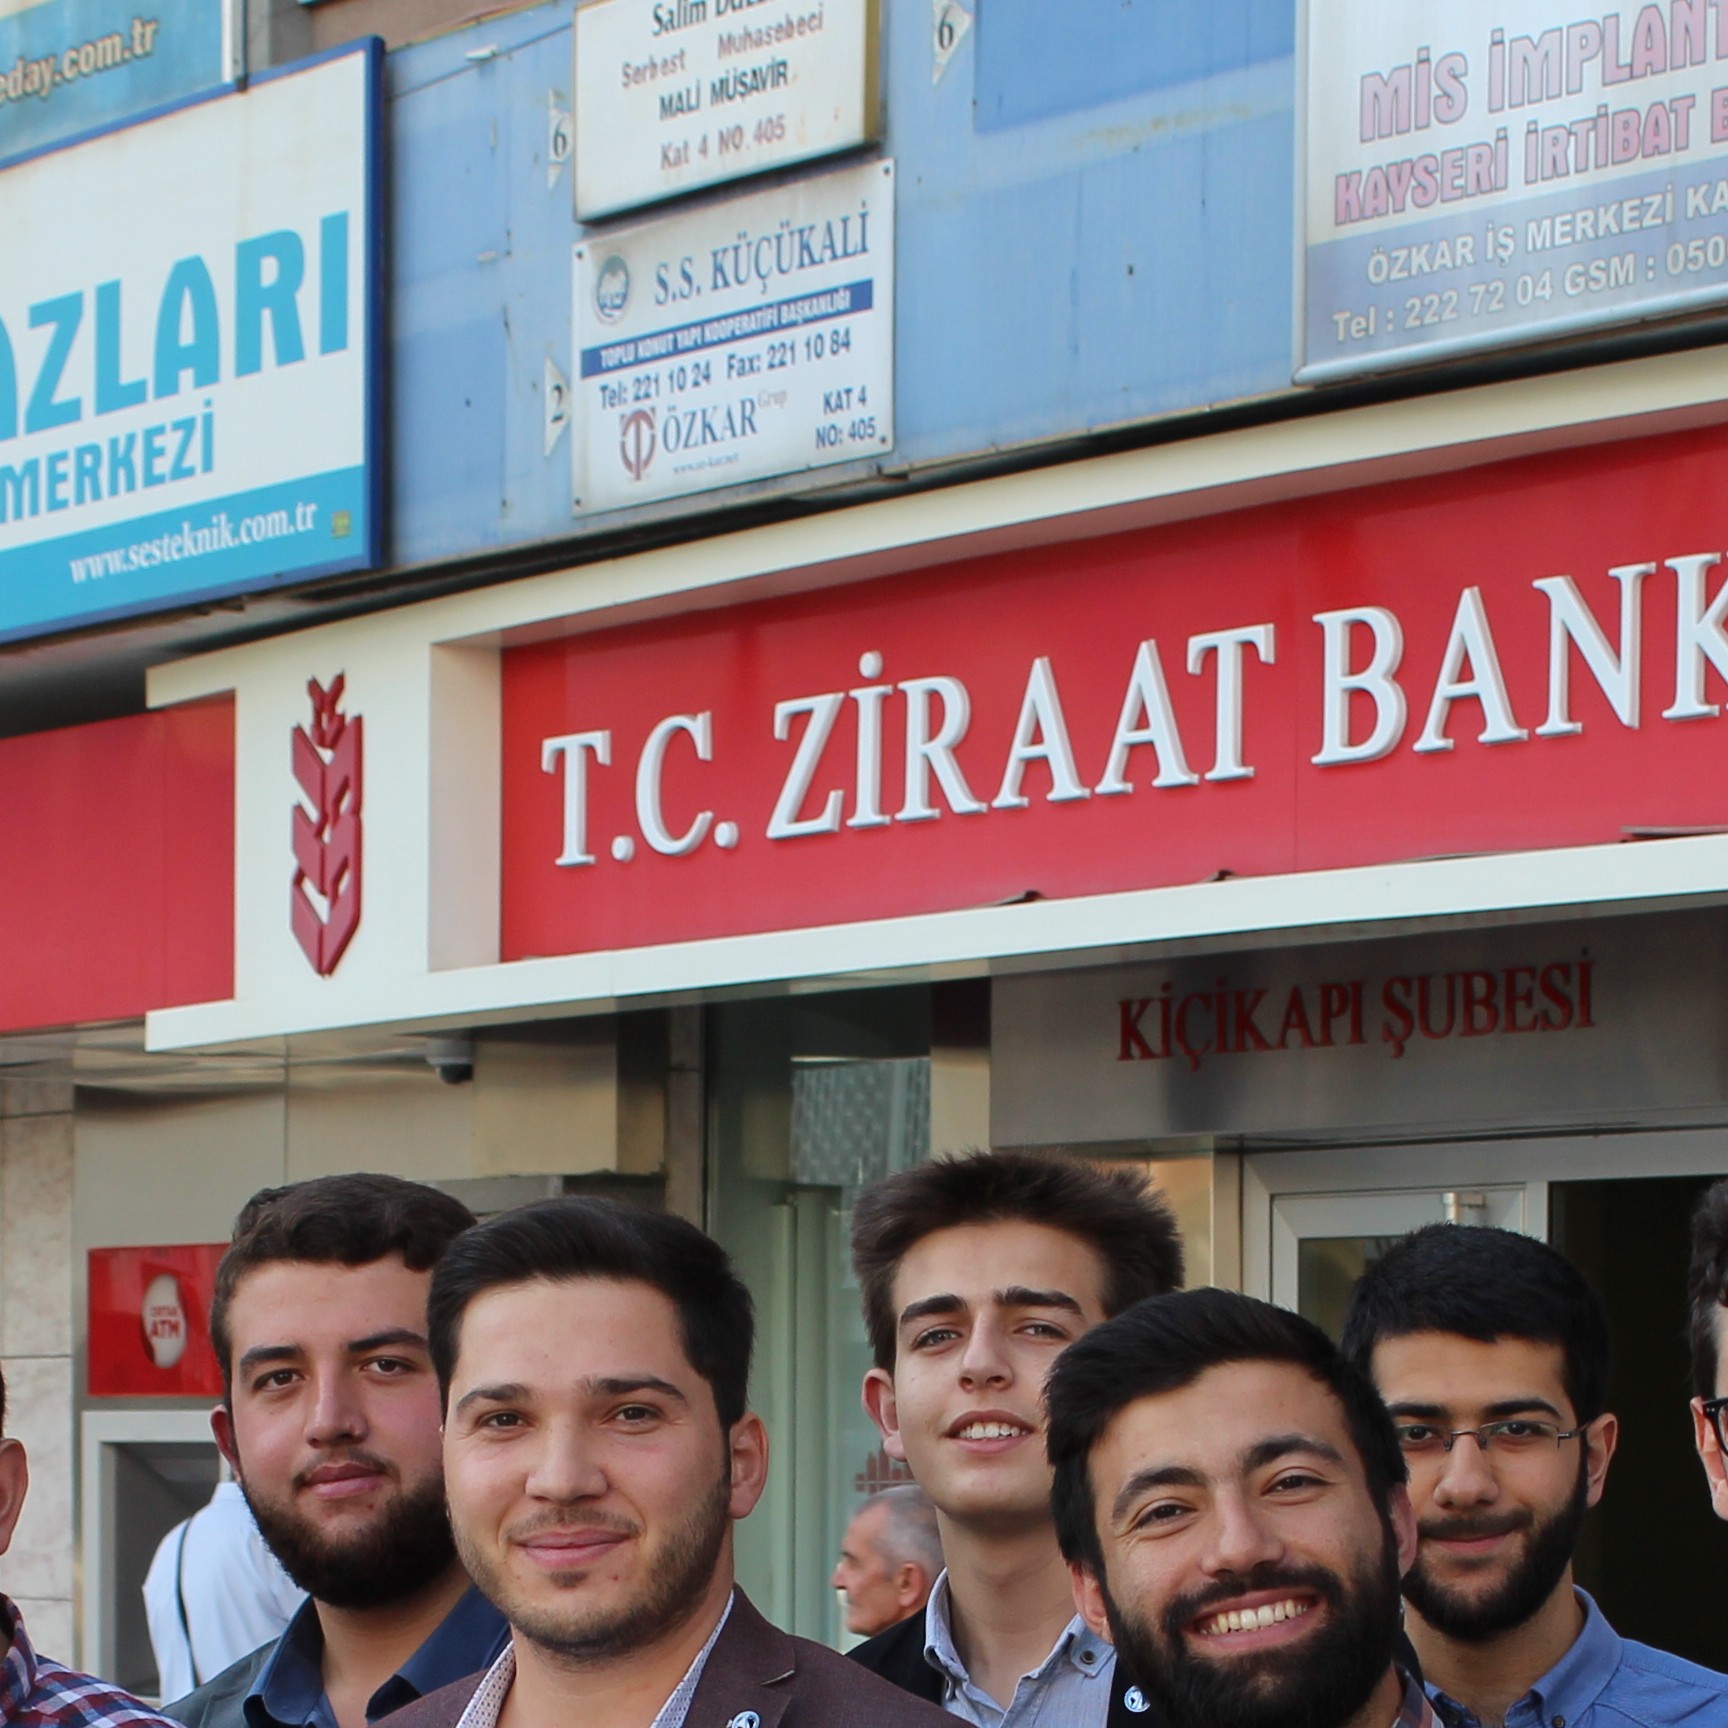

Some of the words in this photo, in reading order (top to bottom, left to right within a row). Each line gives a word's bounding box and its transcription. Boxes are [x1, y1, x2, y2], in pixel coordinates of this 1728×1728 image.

[622, 48, 686, 88] Serbest
[717, 10, 823, 59] Muhasebeci
[660, 79, 701, 120] MALİ
[710, 57, 789, 105] MÜŞAVİR
[1359, 46, 1468, 143] MİS
[660, 143, 689, 170] Kat
[698, 135, 708, 157] 4
[754, 114, 786, 144] 405
[1334, 128, 1509, 227] KAYSERİ
[1524, 95, 1697, 185] İRTİBAT
[654, 255, 702, 305] S.S.
[710, 201, 870, 295] KÜÇÜKALİ
[1366, 232, 1474, 287] ÖZKAR
[1486, 221, 1515, 267] İŞ
[1526, 184, 1674, 254] MERKEZİ
[1333, 310, 1376, 343] Tel
[1404, 294, 1458, 330] 222
[1468, 282, 1505, 318] 72
[1515, 273, 1553, 308] 04
[1563, 252, 1636, 298] GSM
[599, 382, 628, 410] Tel:
[633, 373, 660, 402] 221
[668, 370, 687, 394] 10
[691, 361, 711, 389] 24
[727, 352, 761, 380] Fax:
[767, 341, 796, 370] 221
[805, 334, 824, 361] 10
[829, 327, 851, 355] 84
[823, 387, 854, 415] KAT
[858, 385, 868, 407] 4
[662, 397, 758, 454] ÖZKAR
[815, 423, 843, 450] NO:
[848, 417, 877, 440] 405
[69, 502, 318, 585] www.sesteknik.com.tr
[540, 708, 741, 868] T.C.
[766, 622, 1278, 842] ZİRAAT
[1116, 977, 1365, 1072] KİÇİKAPI
[1381, 947, 1596, 1060] ŞUBESİ
